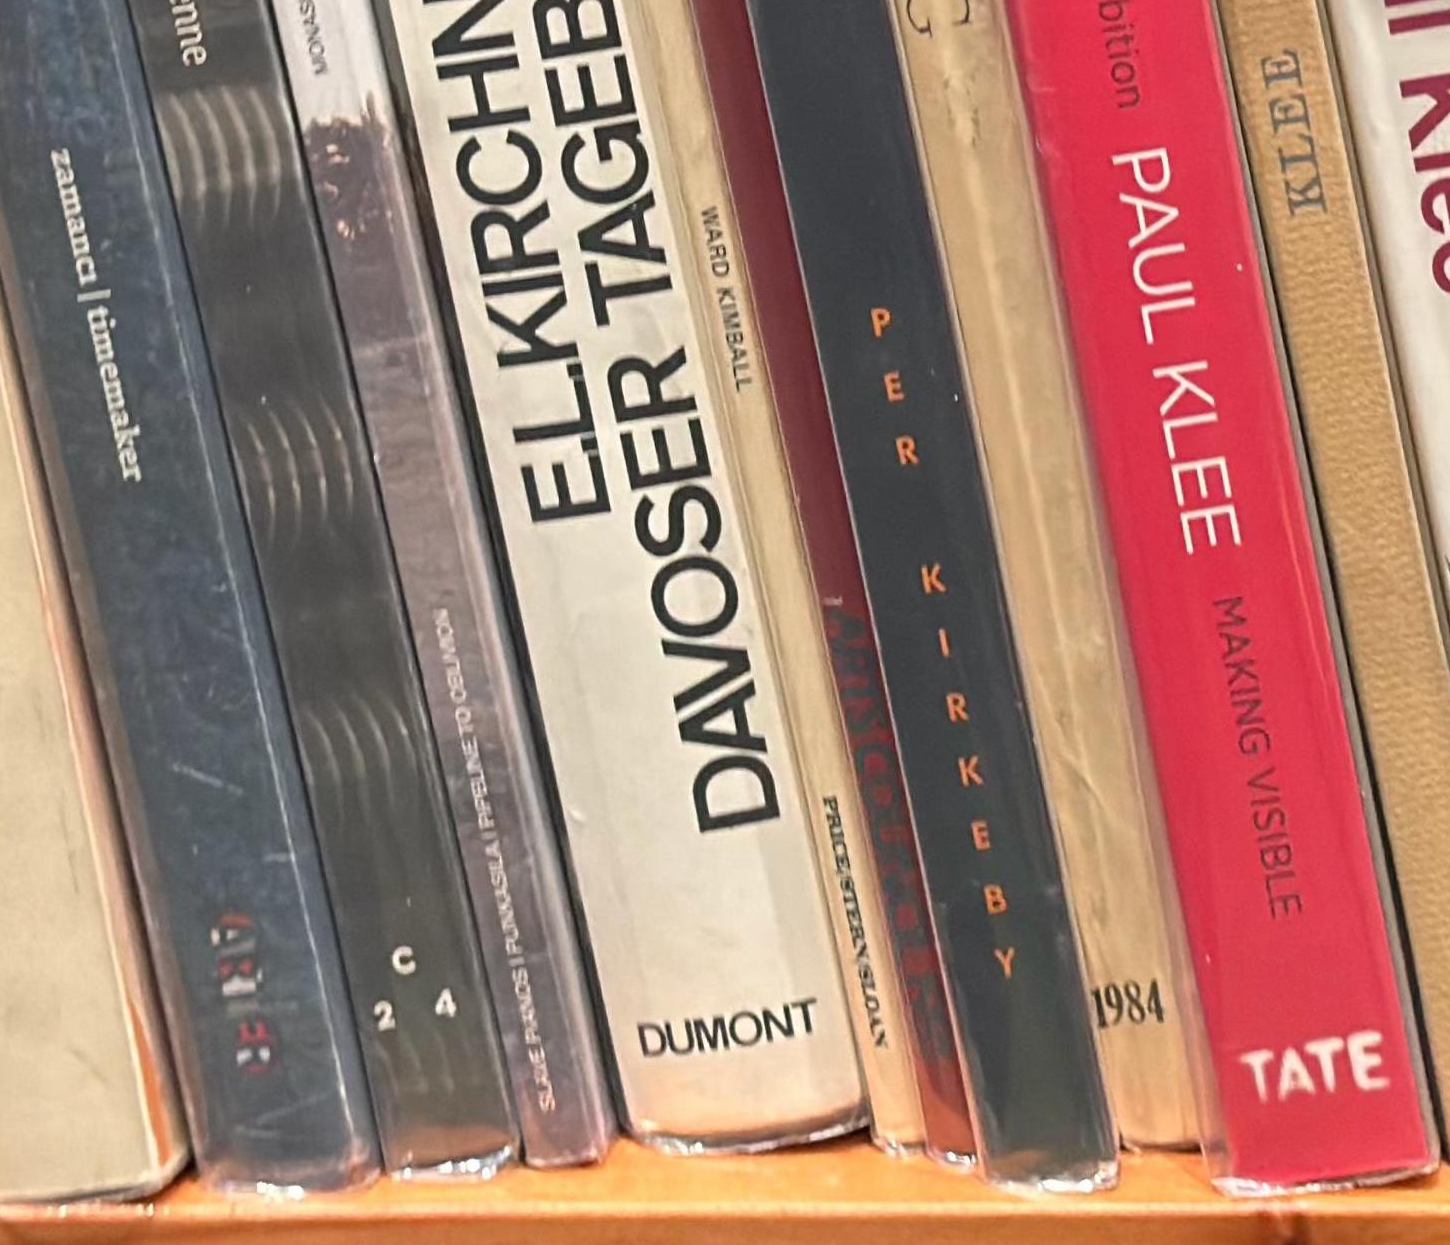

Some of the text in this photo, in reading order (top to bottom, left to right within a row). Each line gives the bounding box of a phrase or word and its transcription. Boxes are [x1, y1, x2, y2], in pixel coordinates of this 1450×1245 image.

[1258, 46, 1329, 220] KLEE
[699, 205, 754, 394] WARD KIMBALL
[1110, 146, 1243, 556] PAUL KLEE
[85, 304, 143, 483] timemaker
[605, 344, 782, 835] DAVOSER
[870, 307, 919, 466] PER
[920, 563, 1018, 979] KIRKEBY
[1211, 594, 1304, 921] MAKING VISIBLE
[432, 607, 557, 1114] SLAVE PIANOS PUNKASILA PIPELINE TO OBLIVION
[373, 1000, 396, 1032] 2
[391, 944, 417, 976] C
[434, 987, 457, 1020] 4
[637, 997, 818, 1058] DUMONT
[1091, 977, 1166, 1030] 1984
[1240, 1029, 1391, 1104] TATE
